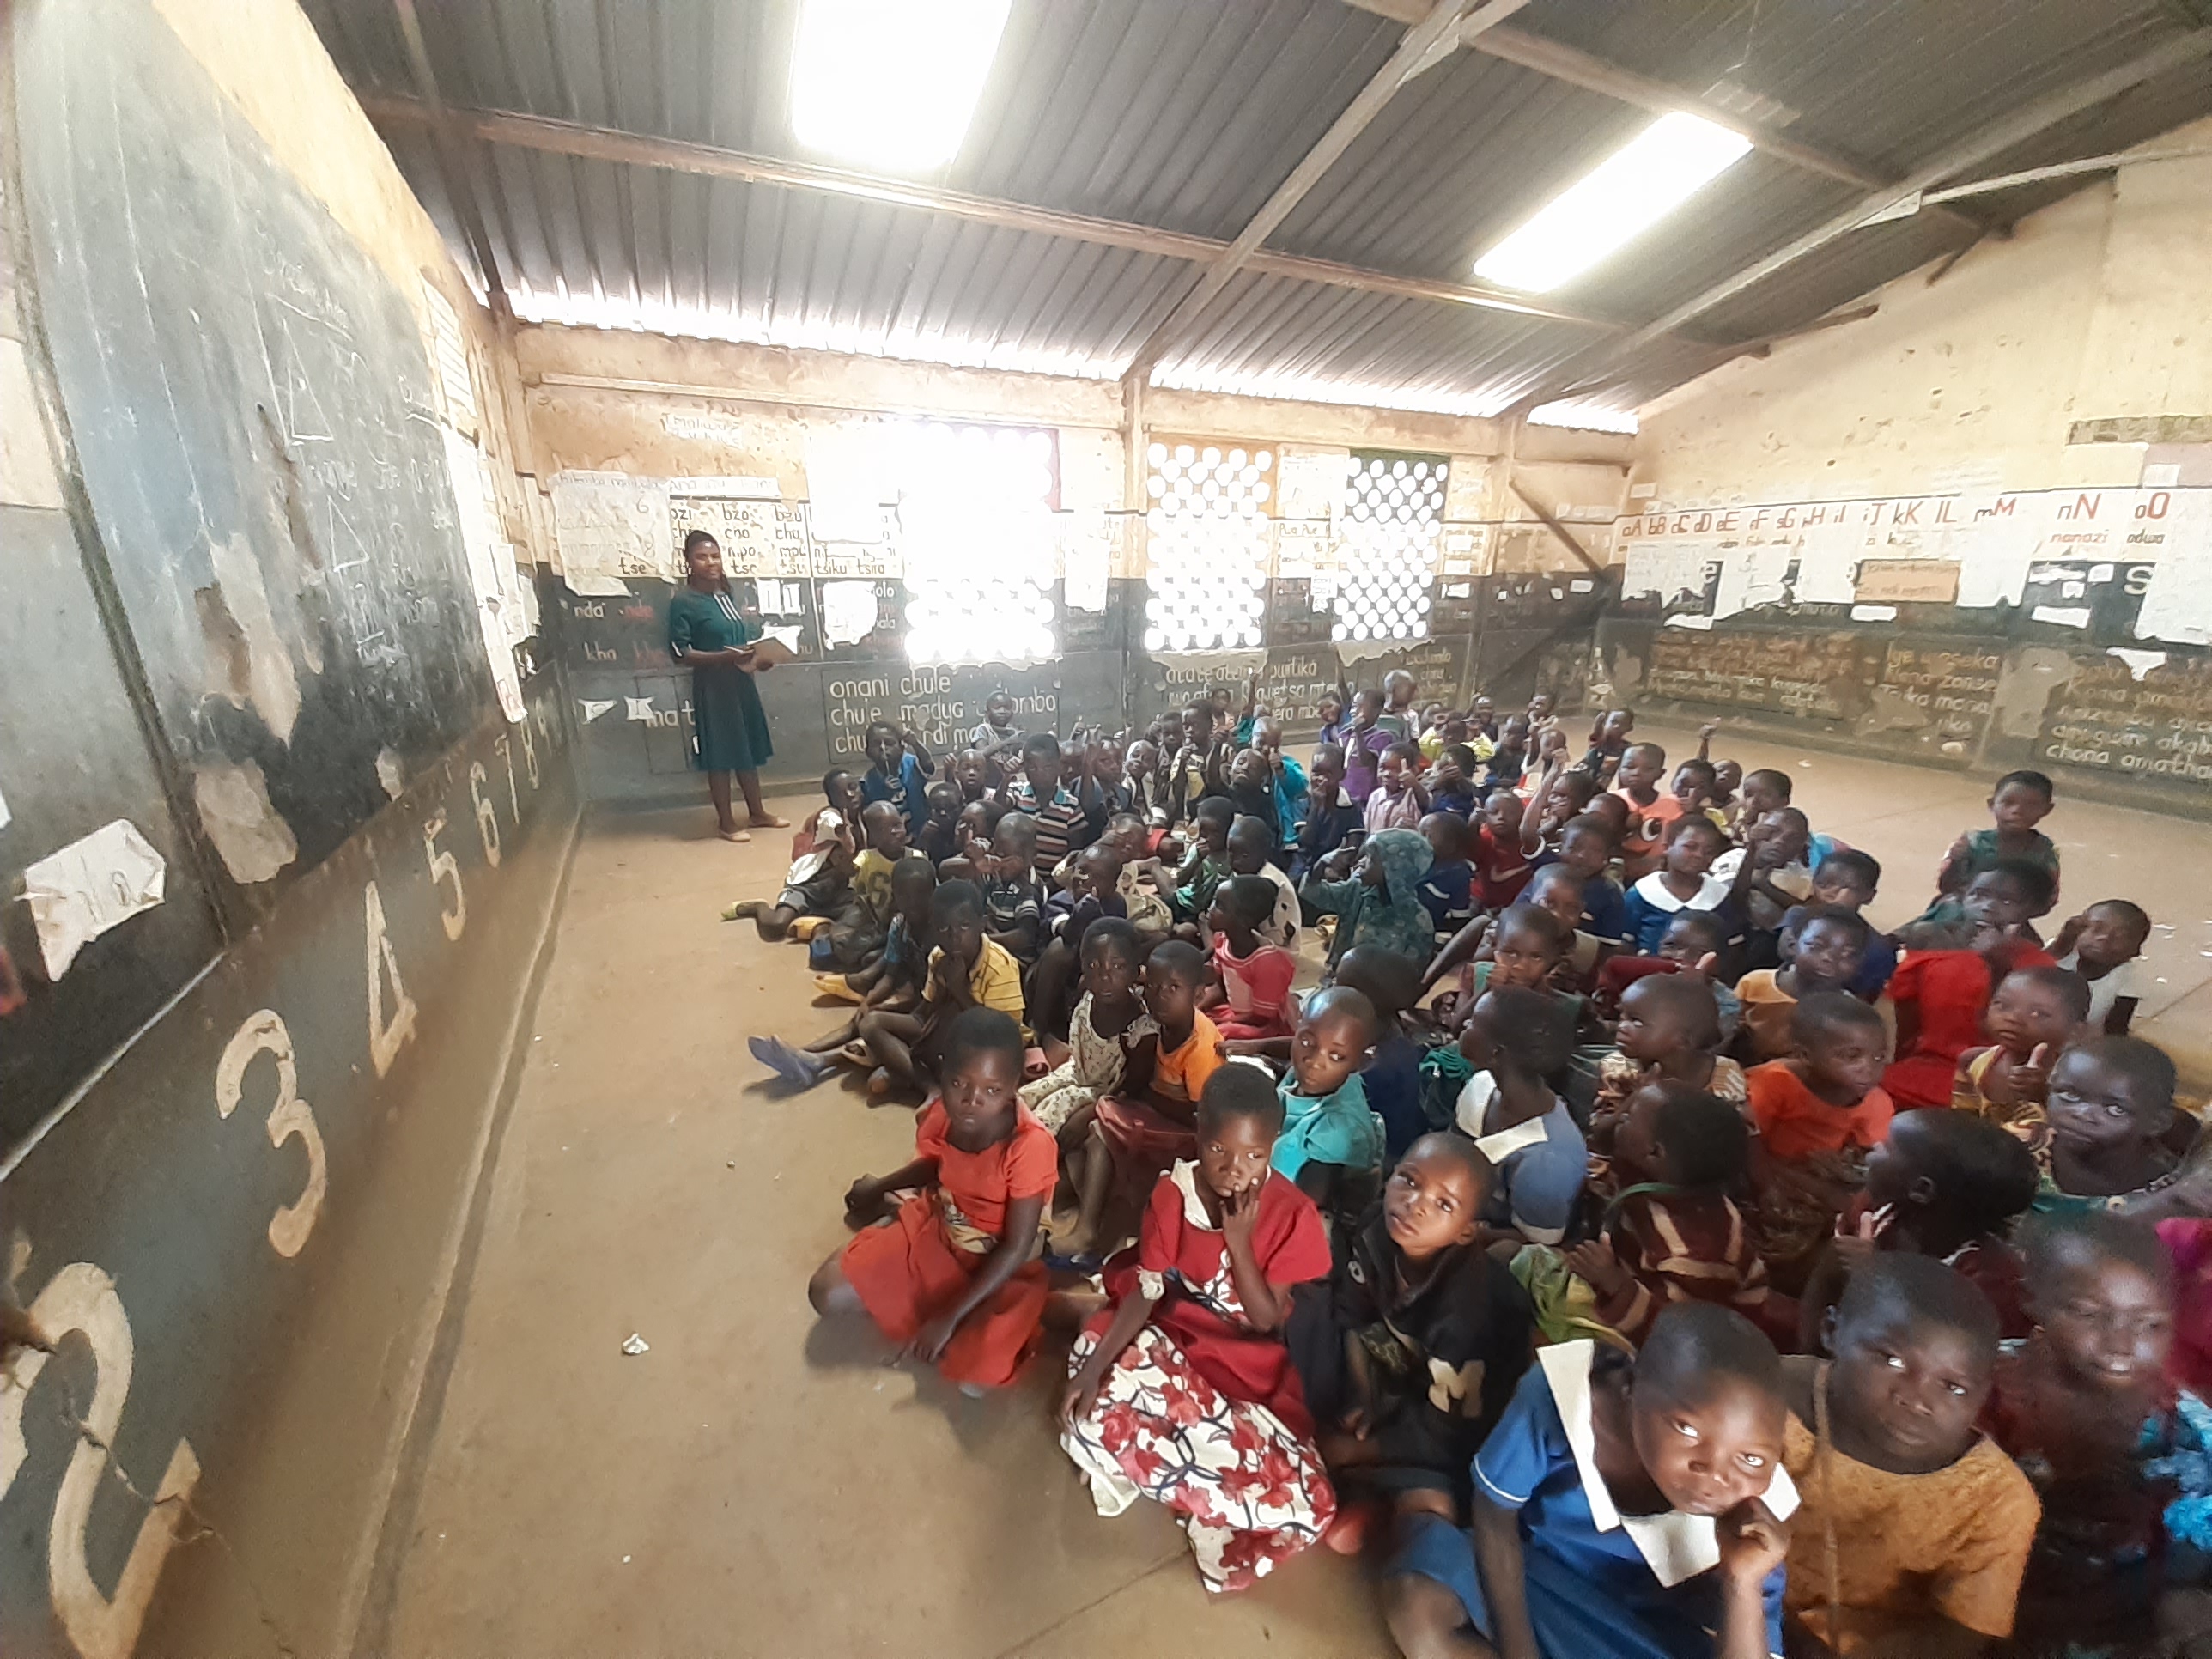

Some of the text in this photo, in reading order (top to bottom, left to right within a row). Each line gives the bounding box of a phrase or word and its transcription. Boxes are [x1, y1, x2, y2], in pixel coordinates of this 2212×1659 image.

[1893, 501, 1924, 526] kK
[1973, 497, 2017, 523] mM
[2057, 493, 2102, 520] nN
[2134, 491, 2171, 520] oO
[830, 666, 951, 698] onani chule
[422, 807, 467, 942] 5
[468, 761, 501, 869] 6
[364, 878, 419, 1080] 4
[216, 1007, 329, 1258] 3
[0, 1261, 200, 1659] 2
